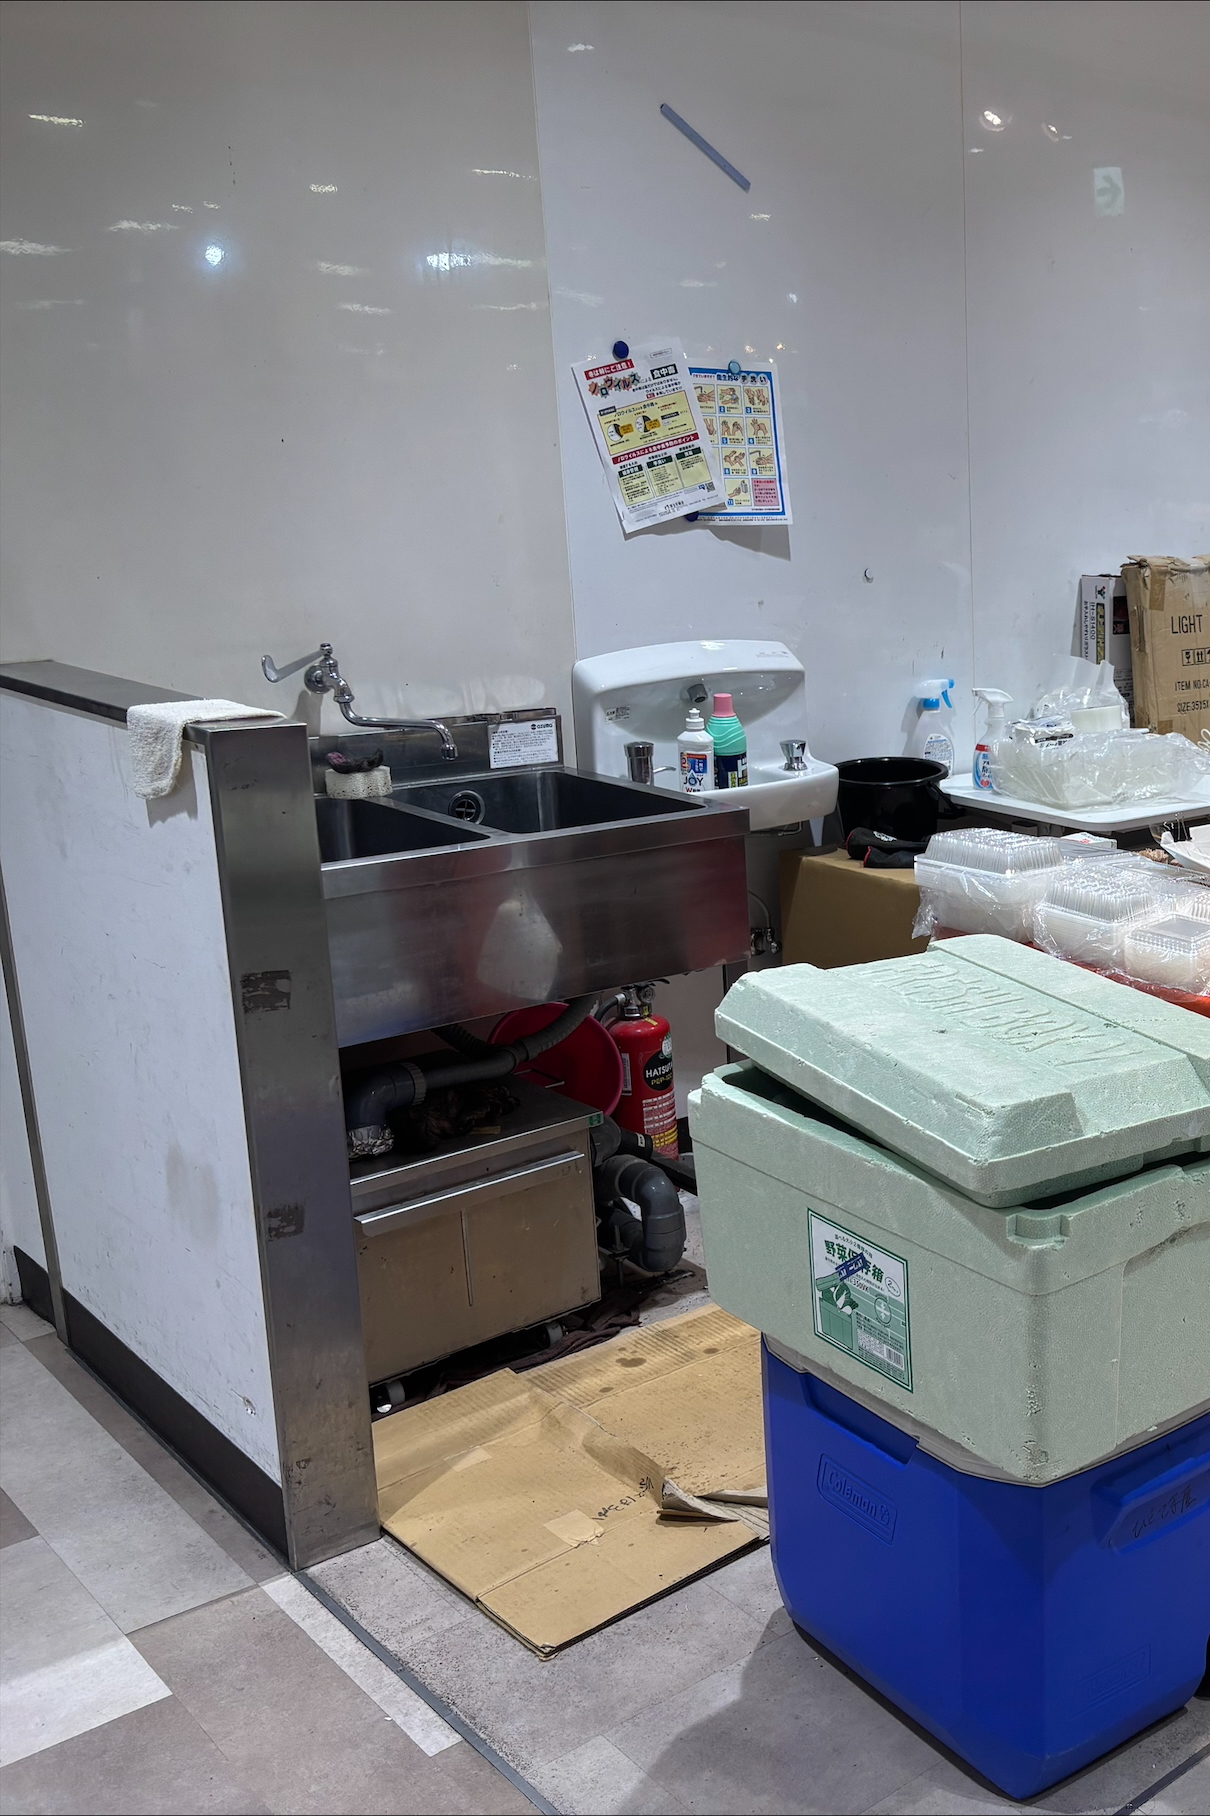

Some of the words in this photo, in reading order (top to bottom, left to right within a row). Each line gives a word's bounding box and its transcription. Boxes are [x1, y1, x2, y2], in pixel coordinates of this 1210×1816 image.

[1171, 614, 1203, 634] LIGHT
[1175, 680, 1191, 691] ITEM
[683, 776, 704, 786] JOY
[828, 1468, 877, 1519] Coleman
